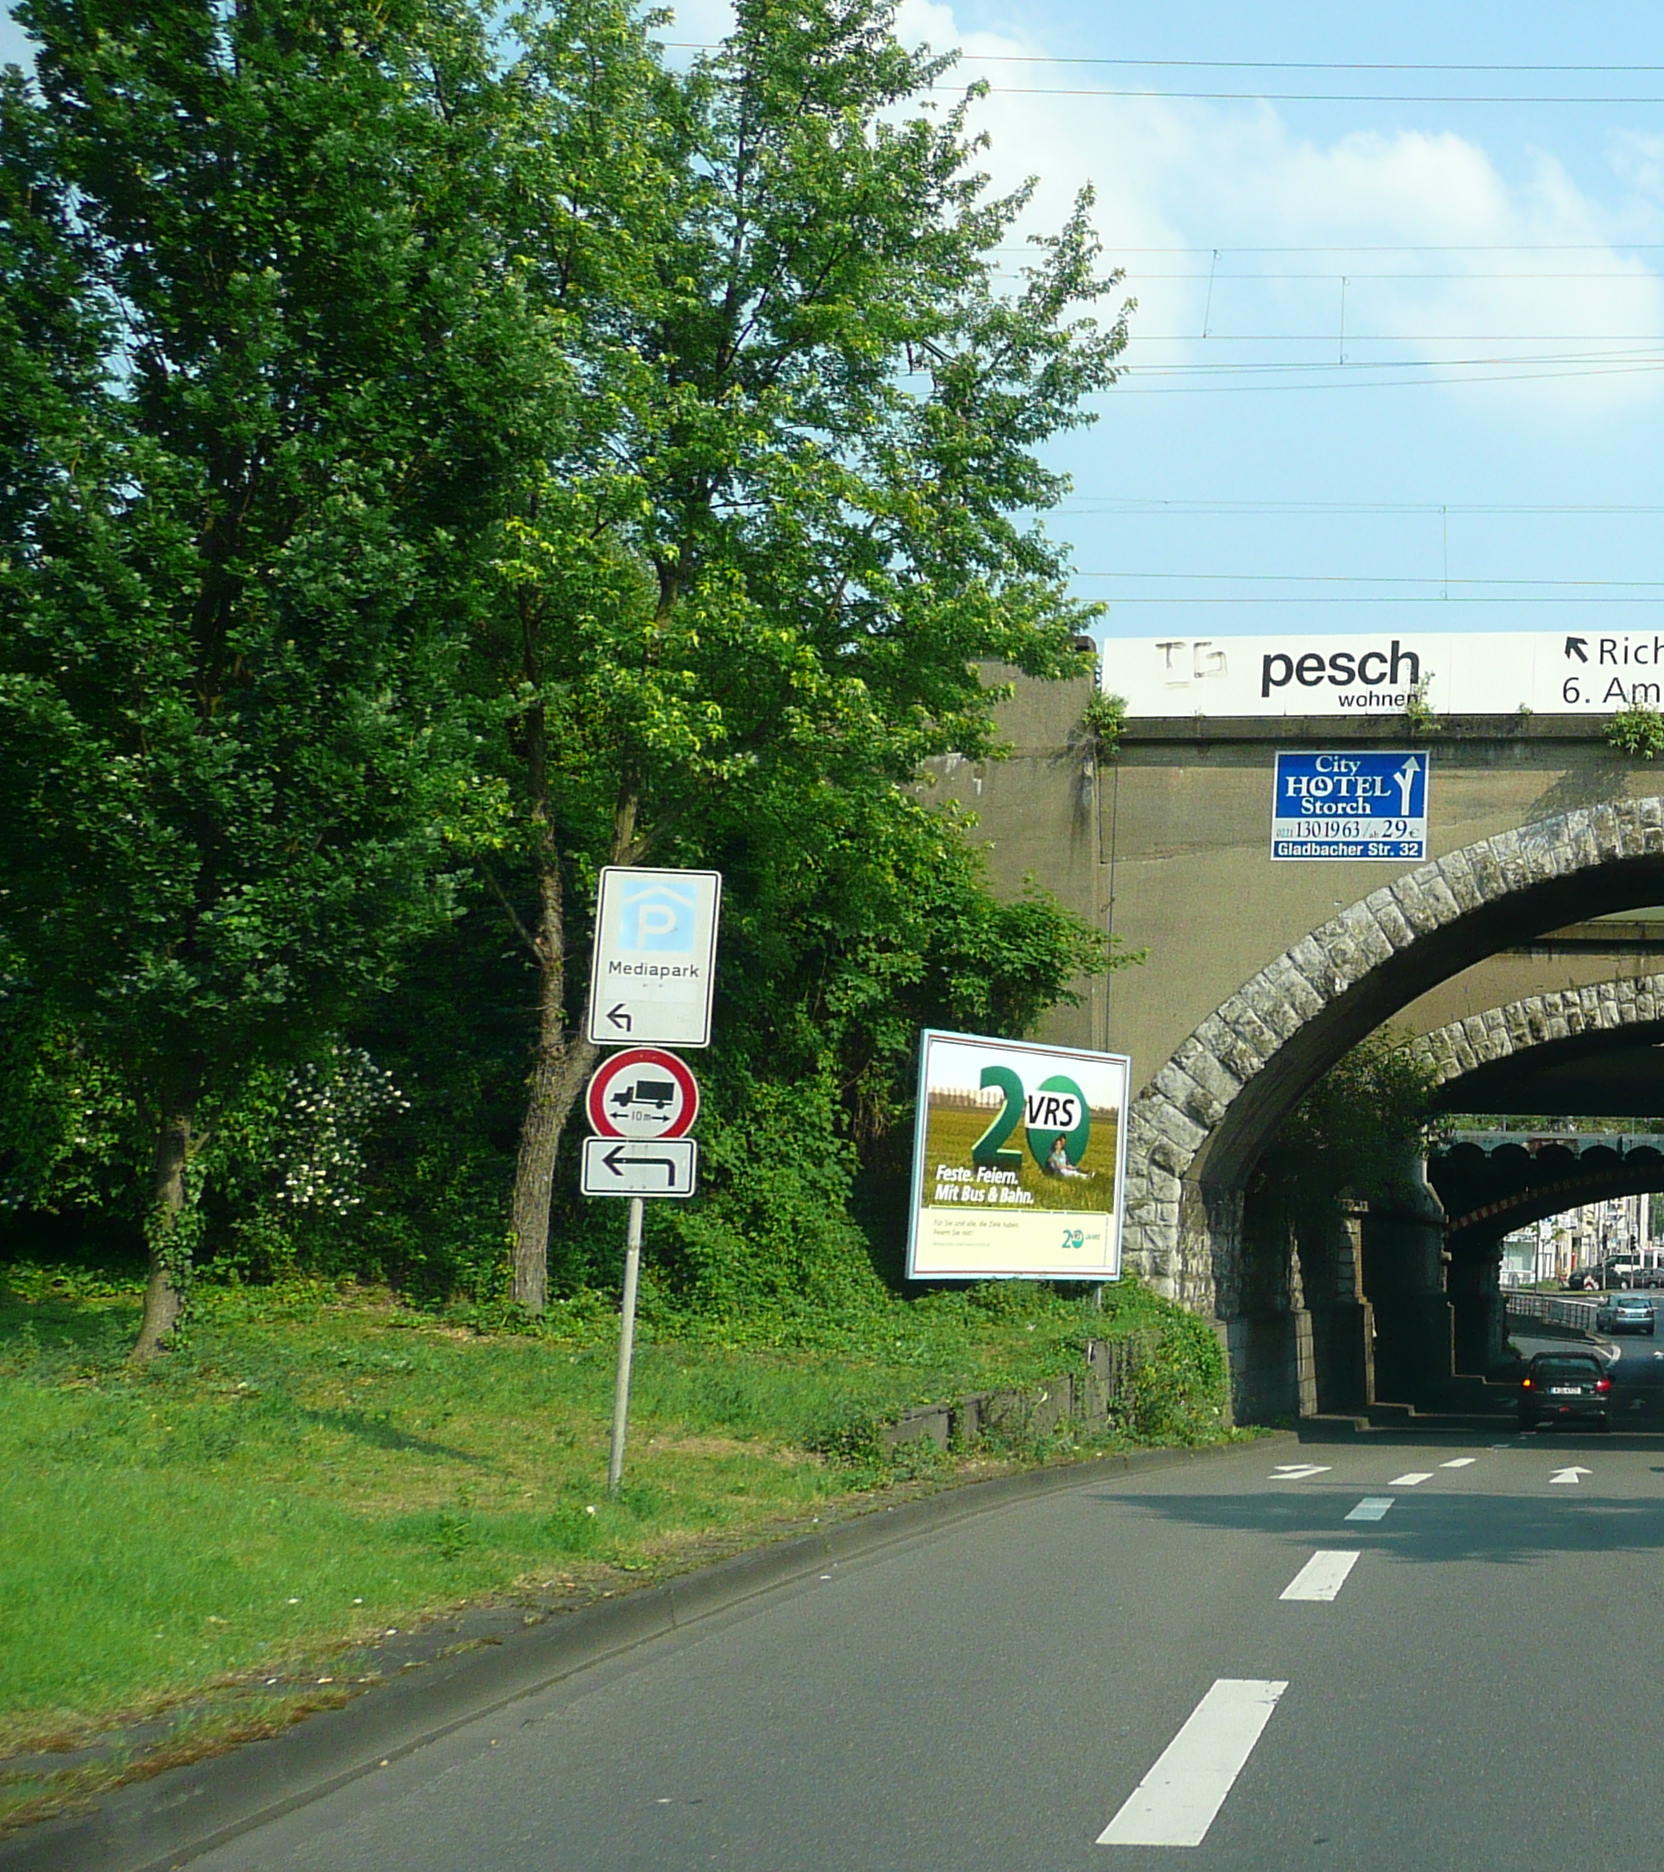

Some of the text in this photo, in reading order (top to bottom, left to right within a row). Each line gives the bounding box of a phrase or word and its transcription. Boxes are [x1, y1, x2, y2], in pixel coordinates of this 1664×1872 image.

[1261, 640, 1420, 698] pesch
[1338, 690, 1420, 708] wohnen
[1562, 676, 1591, 704] 6.
[1315, 755, 1362, 776] City
[1285, 776, 1392, 797] HOTEL
[1301, 797, 1372, 815] Storch
[1278, 843, 1419, 856] Gladbacher Str. 32
[608, 960, 700, 978] Mediapark
[1027, 1094, 1075, 1127] VRS
[936, 1164, 1019, 1185] Feste. Feiern.
[934, 1183, 1034, 1205] Mit Bus & Bahn.
